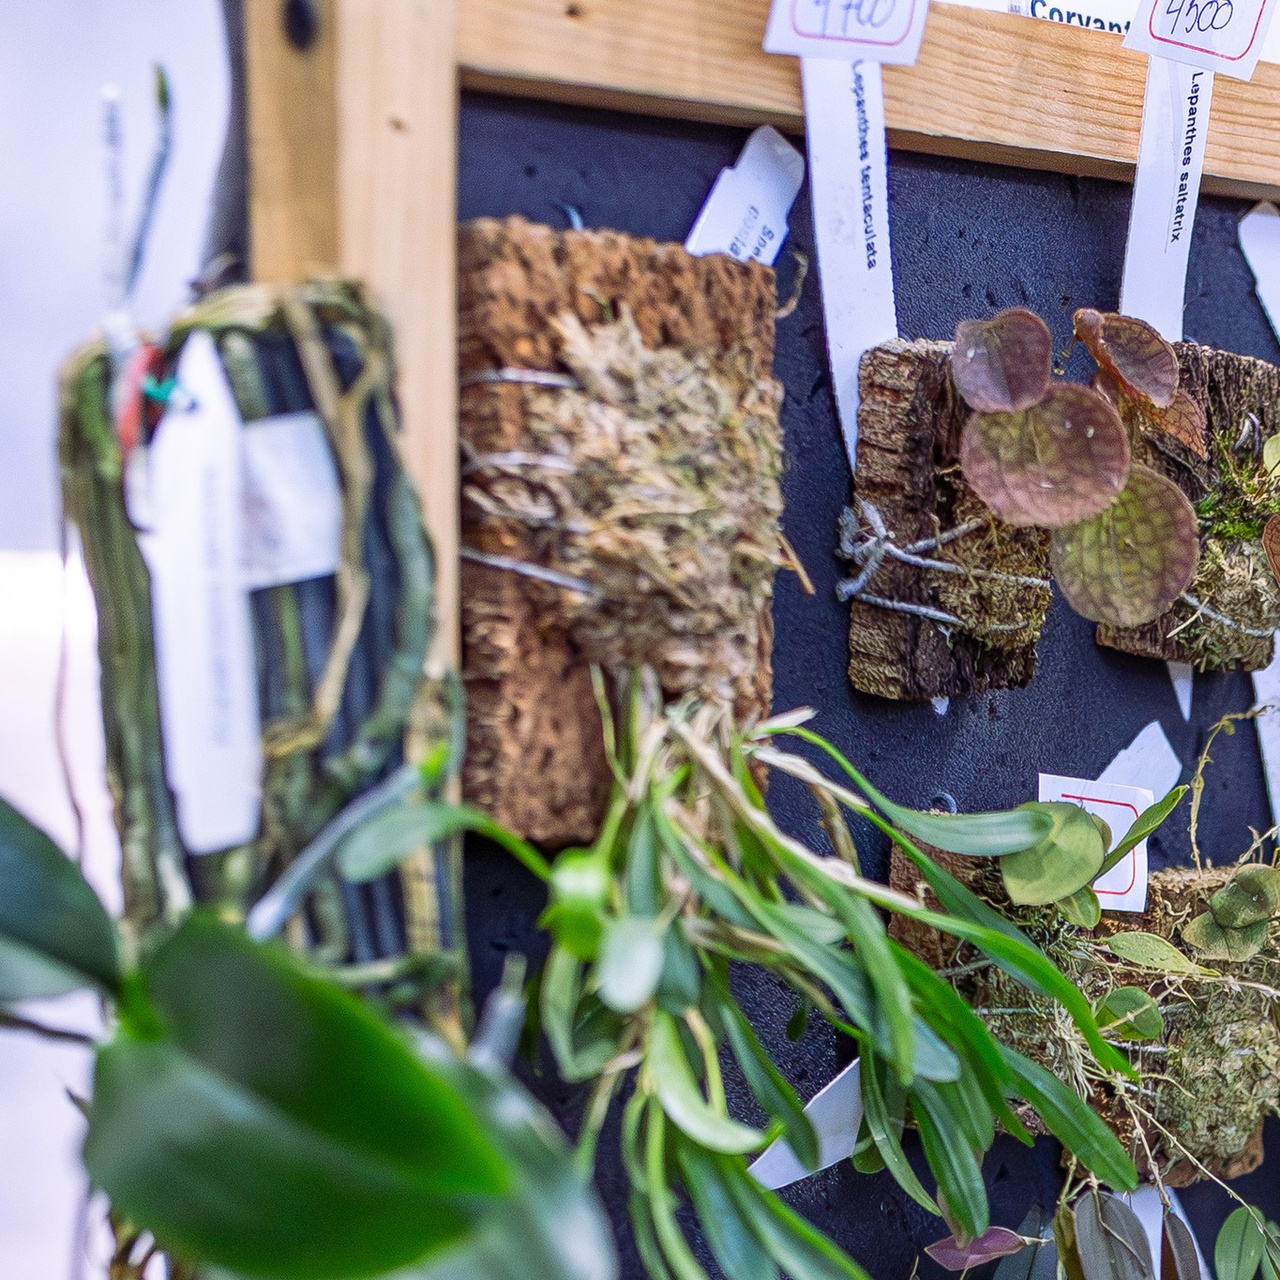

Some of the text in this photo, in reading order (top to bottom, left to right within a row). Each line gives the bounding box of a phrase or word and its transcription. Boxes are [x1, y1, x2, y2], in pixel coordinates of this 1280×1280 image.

[852, 58, 878, 271] Lepanthes tentaculata
[1170, 71, 1204, 243] Lepanthes saltatrix
